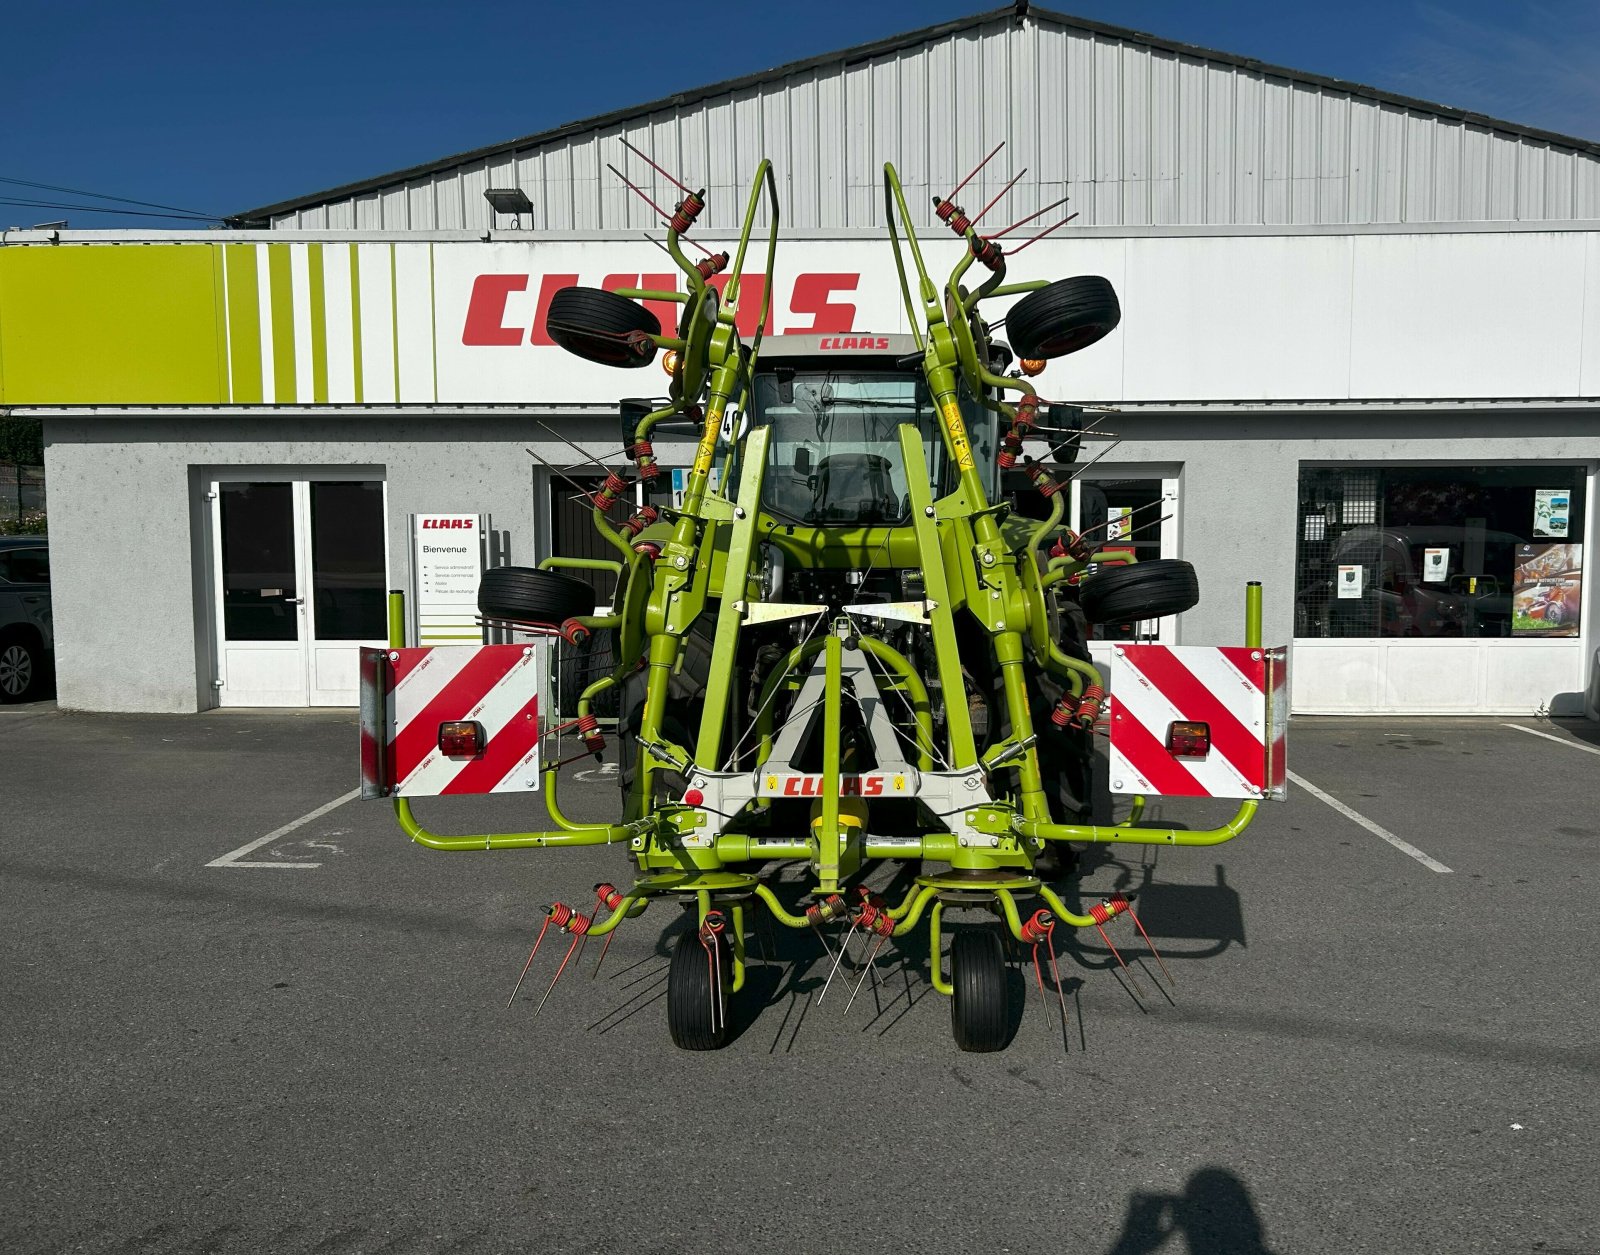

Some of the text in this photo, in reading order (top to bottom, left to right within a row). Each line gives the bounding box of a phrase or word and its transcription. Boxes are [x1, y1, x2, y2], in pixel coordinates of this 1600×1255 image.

[820, 337, 889, 349] CLAAS
[423, 519, 473, 529] CLAAS
[784, 777, 884, 795] CLAS
